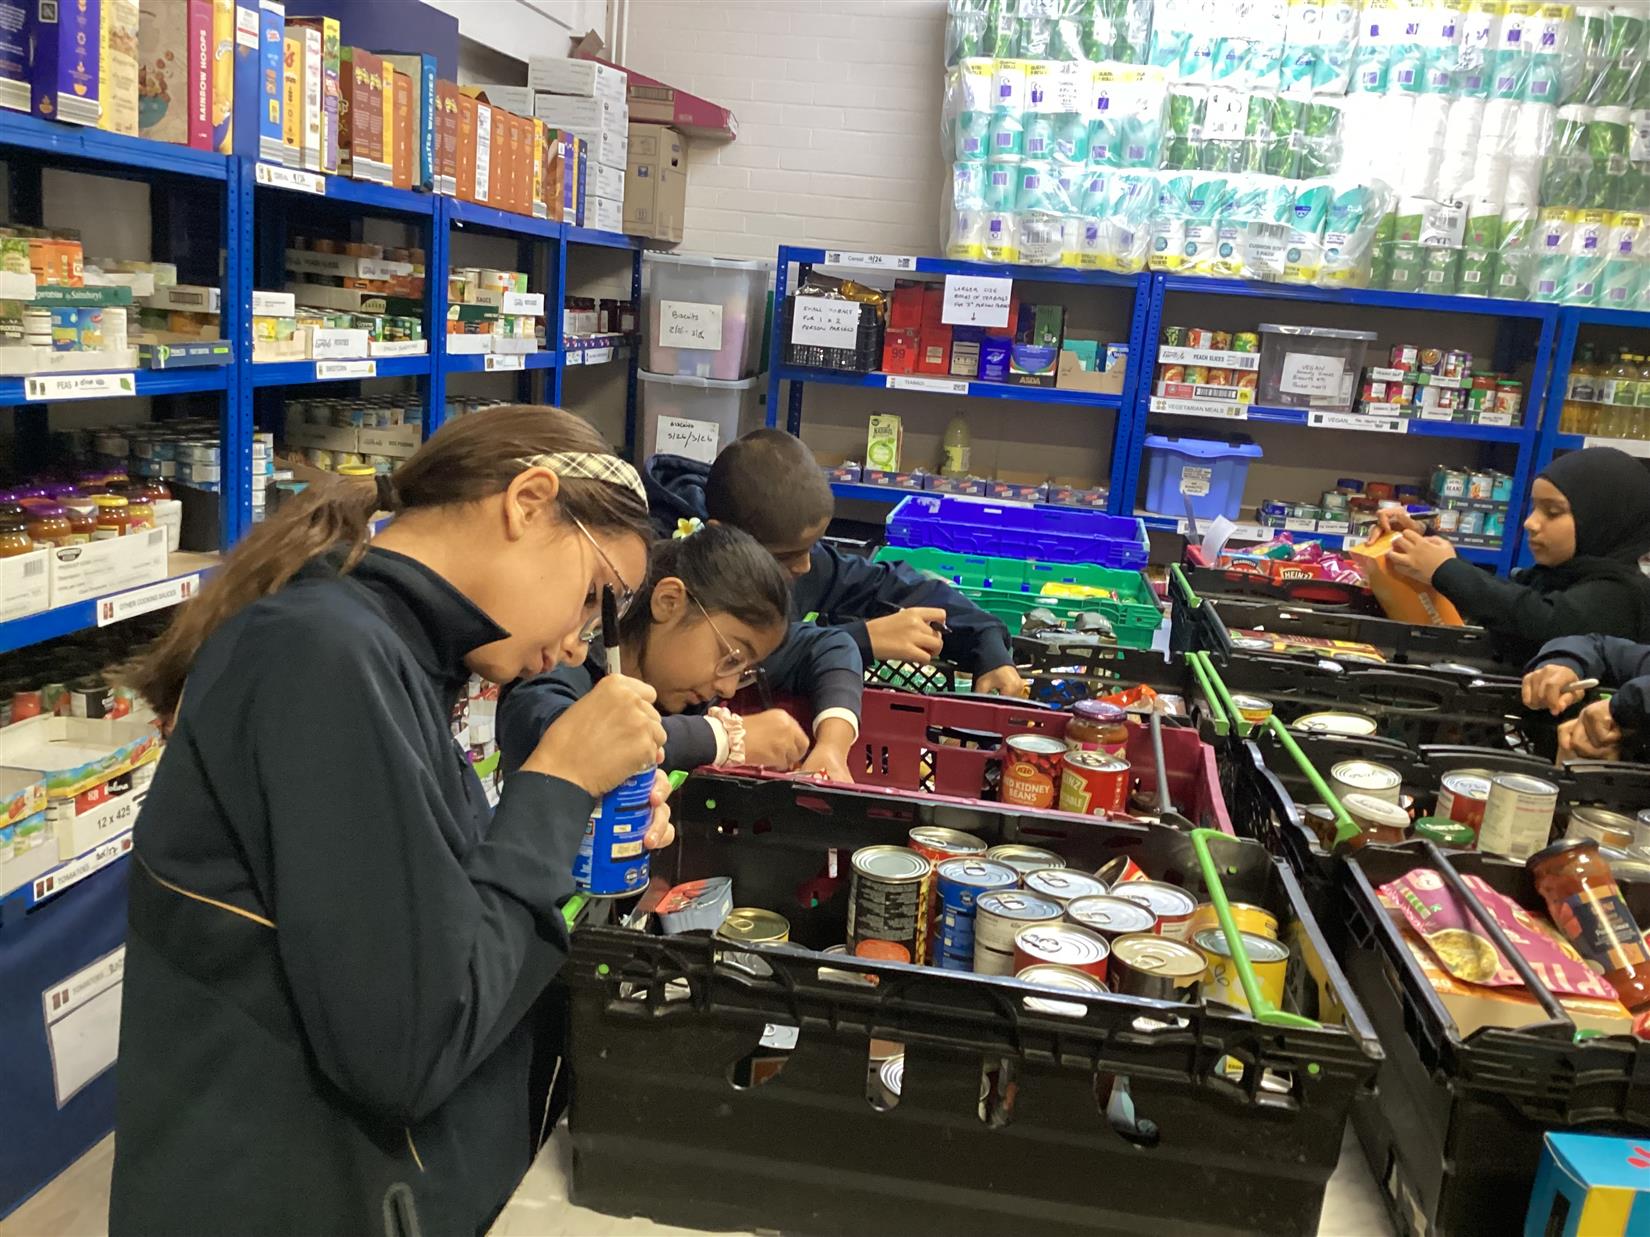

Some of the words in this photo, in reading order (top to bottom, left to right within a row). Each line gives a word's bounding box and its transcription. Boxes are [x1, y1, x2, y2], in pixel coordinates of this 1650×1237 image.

[1019, 376, 1041, 386] ASDA
[1283, 570, 1313, 580] HEINZ
[1015, 782, 1050, 794] KIDNEY
[1009, 788, 1037, 802] BEANS
[98, 814, 107, 829] 12
[117, 804, 131, 819] 425
